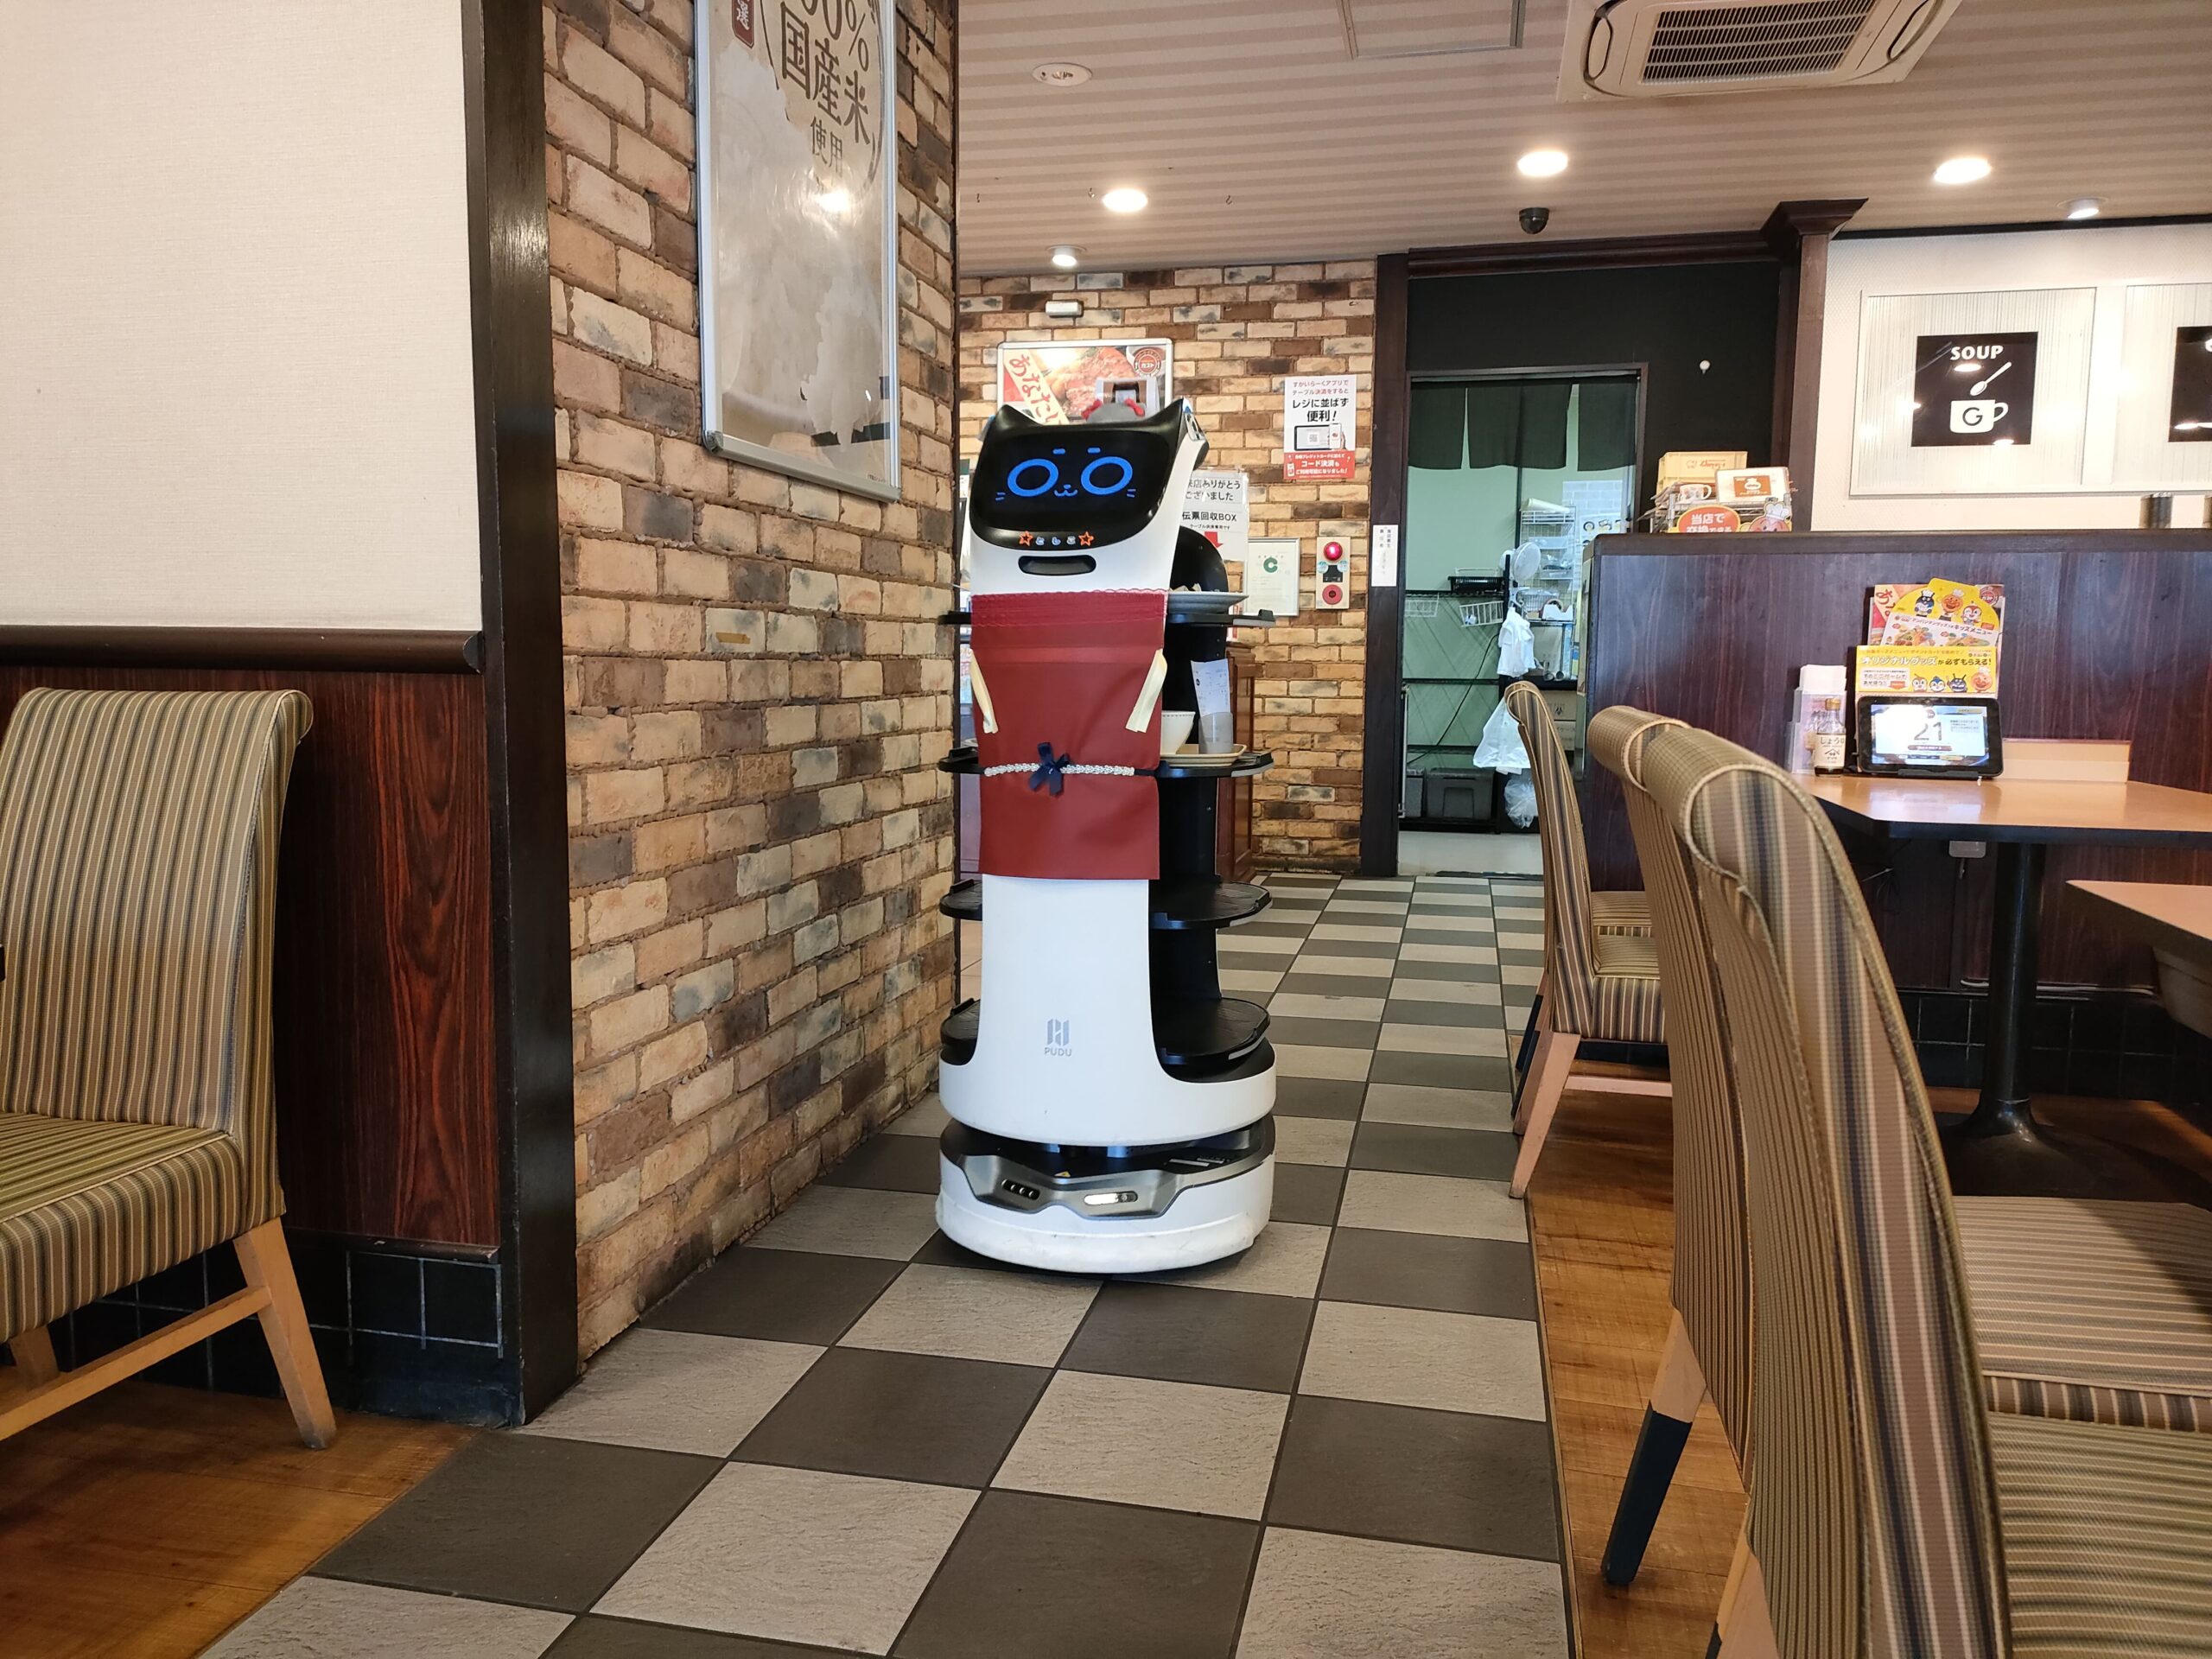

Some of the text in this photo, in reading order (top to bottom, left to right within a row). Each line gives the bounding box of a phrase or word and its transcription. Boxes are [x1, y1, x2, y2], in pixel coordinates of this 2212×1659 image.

[780, 2, 871, 144] 国産米
[810, 117, 843, 178] 使用
[1950, 345, 2004, 360] SOUP
[1293, 397, 1350, 409] レジに並ばず
[1962, 406, 1983, 426] G
[1182, 511, 1237, 522] 伝票回収BOX
[1691, 513, 1725, 524] 当店で
[1914, 721, 1942, 741] 21
[1044, 1046, 1072, 1058] PUDU
